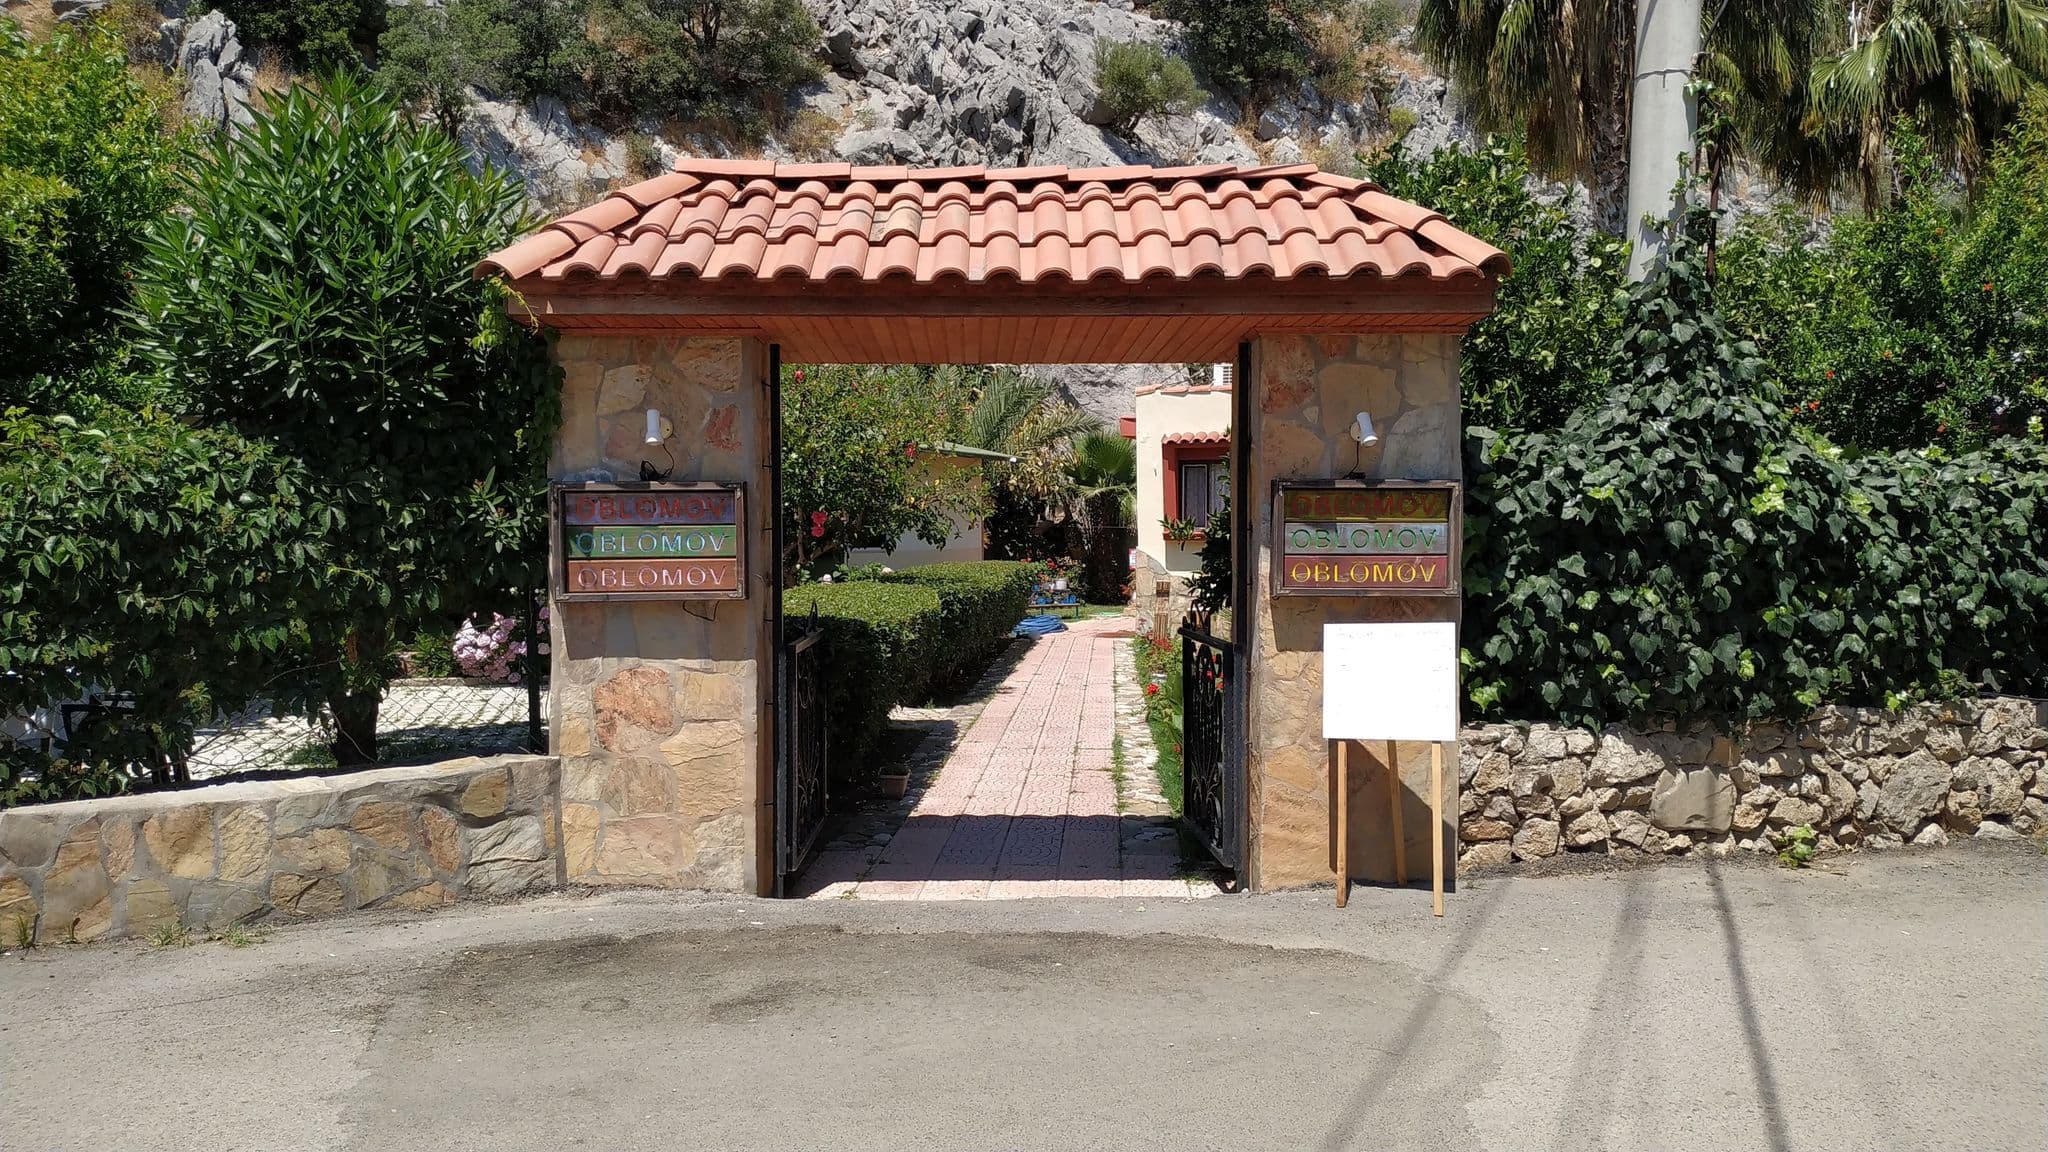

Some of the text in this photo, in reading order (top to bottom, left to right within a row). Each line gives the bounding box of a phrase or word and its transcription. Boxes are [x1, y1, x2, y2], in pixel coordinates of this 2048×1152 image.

[576, 498, 726, 519] OBLOMOV
[1292, 497, 1436, 516] OBLOMOV
[577, 532, 727, 552] OBLOMOV
[1291, 529, 1437, 548] OBLOMOV
[578, 568, 726, 588] OBLOMOV
[1291, 563, 1436, 583] OBLOMOV
